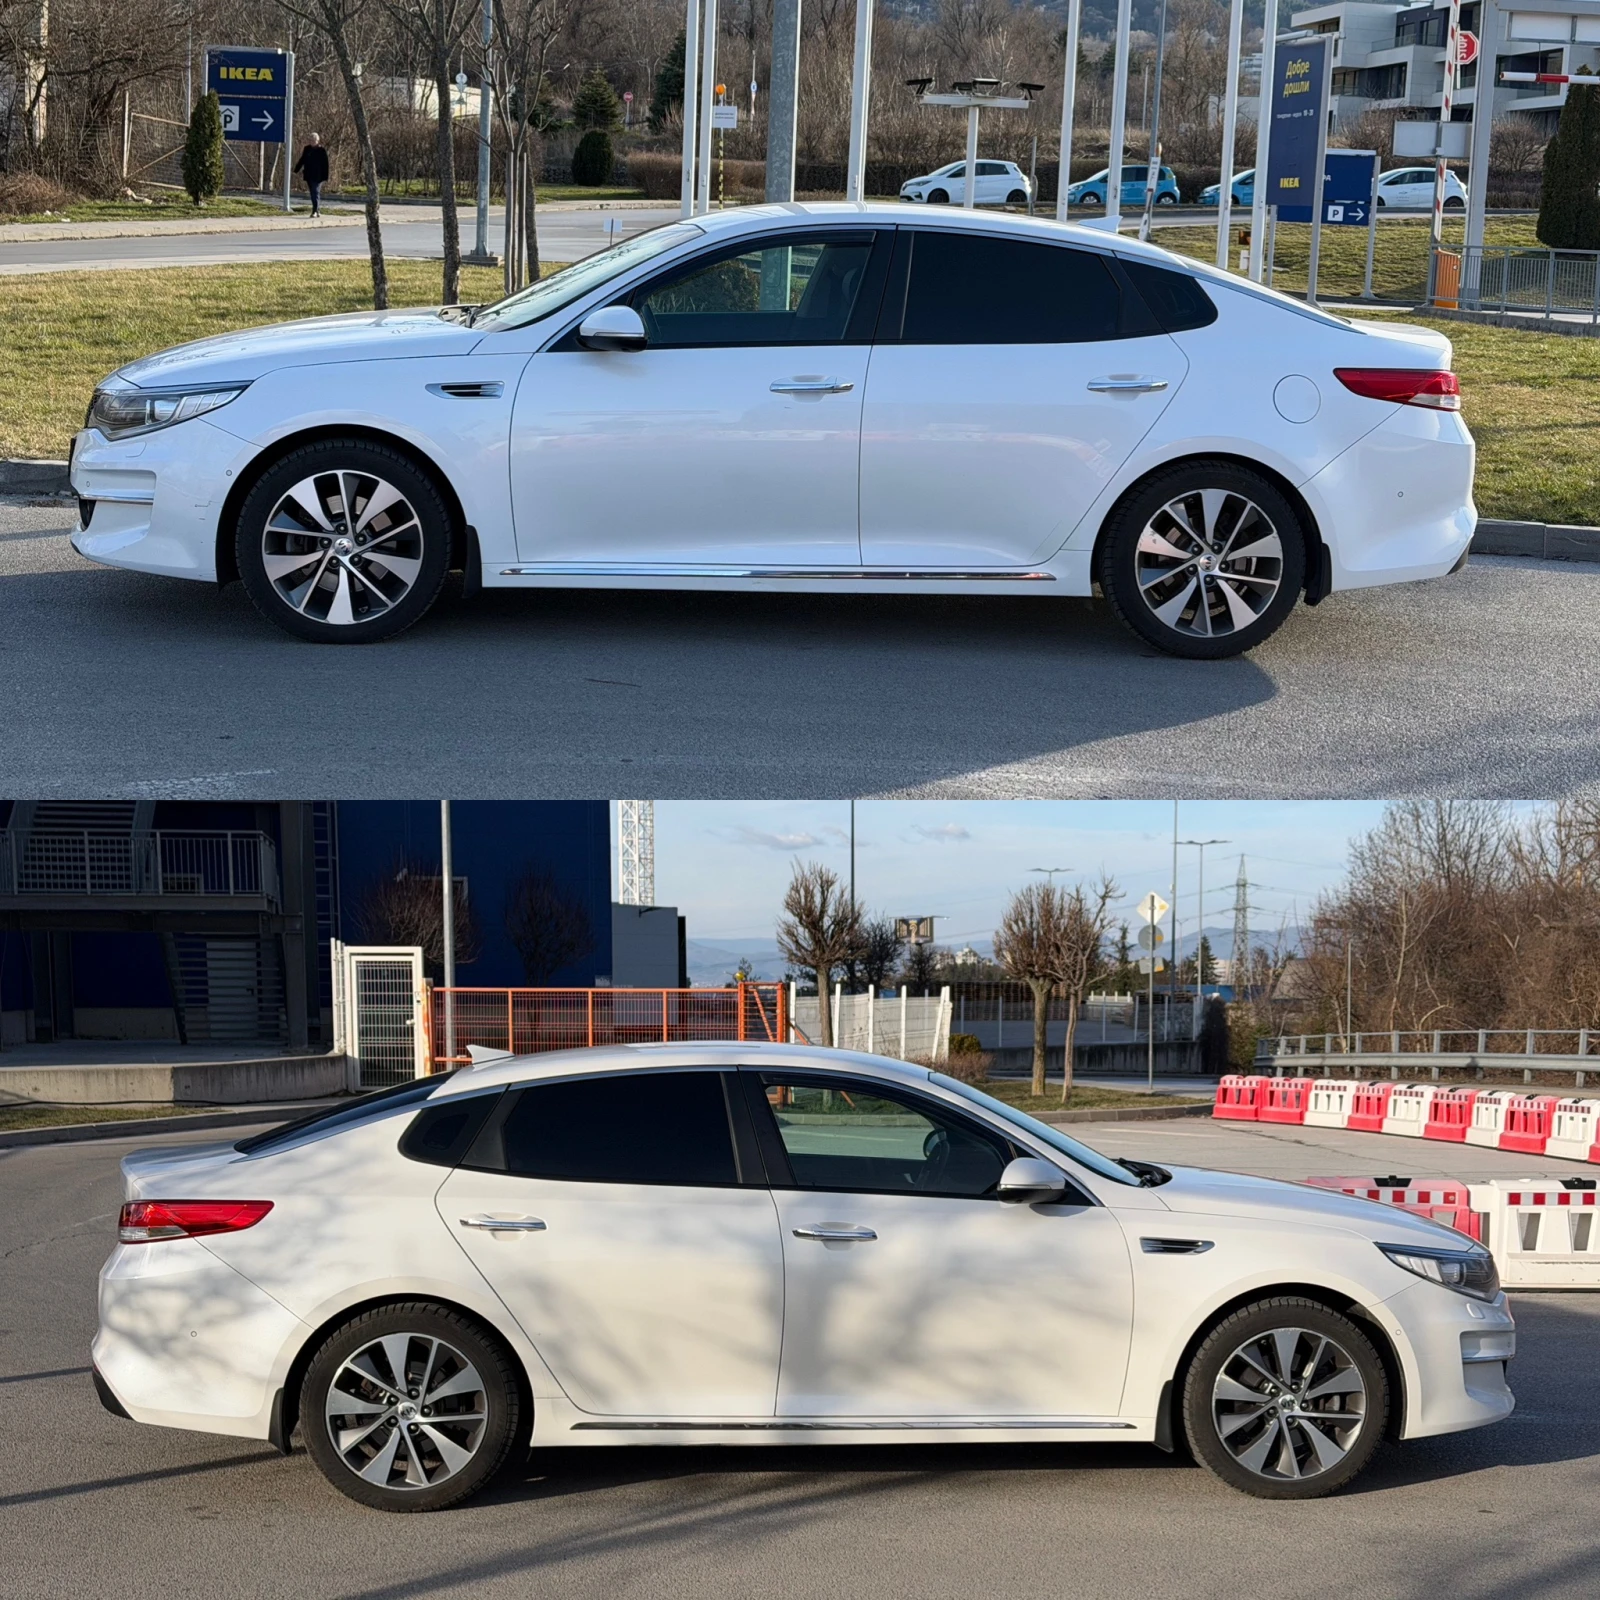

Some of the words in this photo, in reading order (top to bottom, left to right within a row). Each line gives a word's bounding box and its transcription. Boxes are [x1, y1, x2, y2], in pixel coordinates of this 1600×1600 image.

[1459, 35, 1468, 59] STOP
[220, 67, 273, 81] IKEA
[1286, 59, 1310, 79] Добре
[1283, 81, 1310, 98] дошли
[223, 114, 233, 129] P
[1280, 177, 1300, 188] IKEA
[1332, 209, 1340, 218] P
